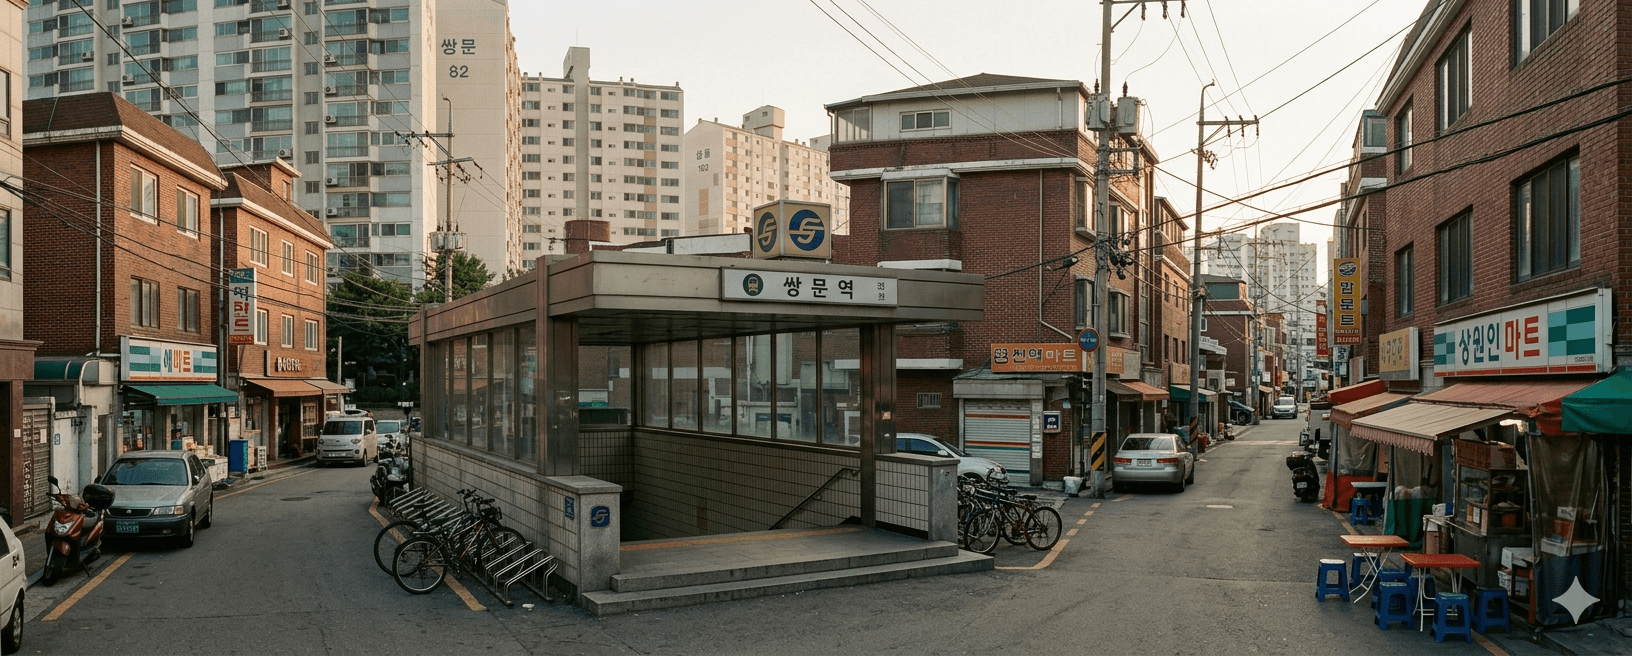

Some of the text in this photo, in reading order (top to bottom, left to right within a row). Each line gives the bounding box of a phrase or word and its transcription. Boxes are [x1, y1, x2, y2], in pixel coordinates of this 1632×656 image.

[441, 38, 476, 55] 쌍문
[449, 64, 469, 78] 82
[783, 276, 853, 300] 쌍문역
